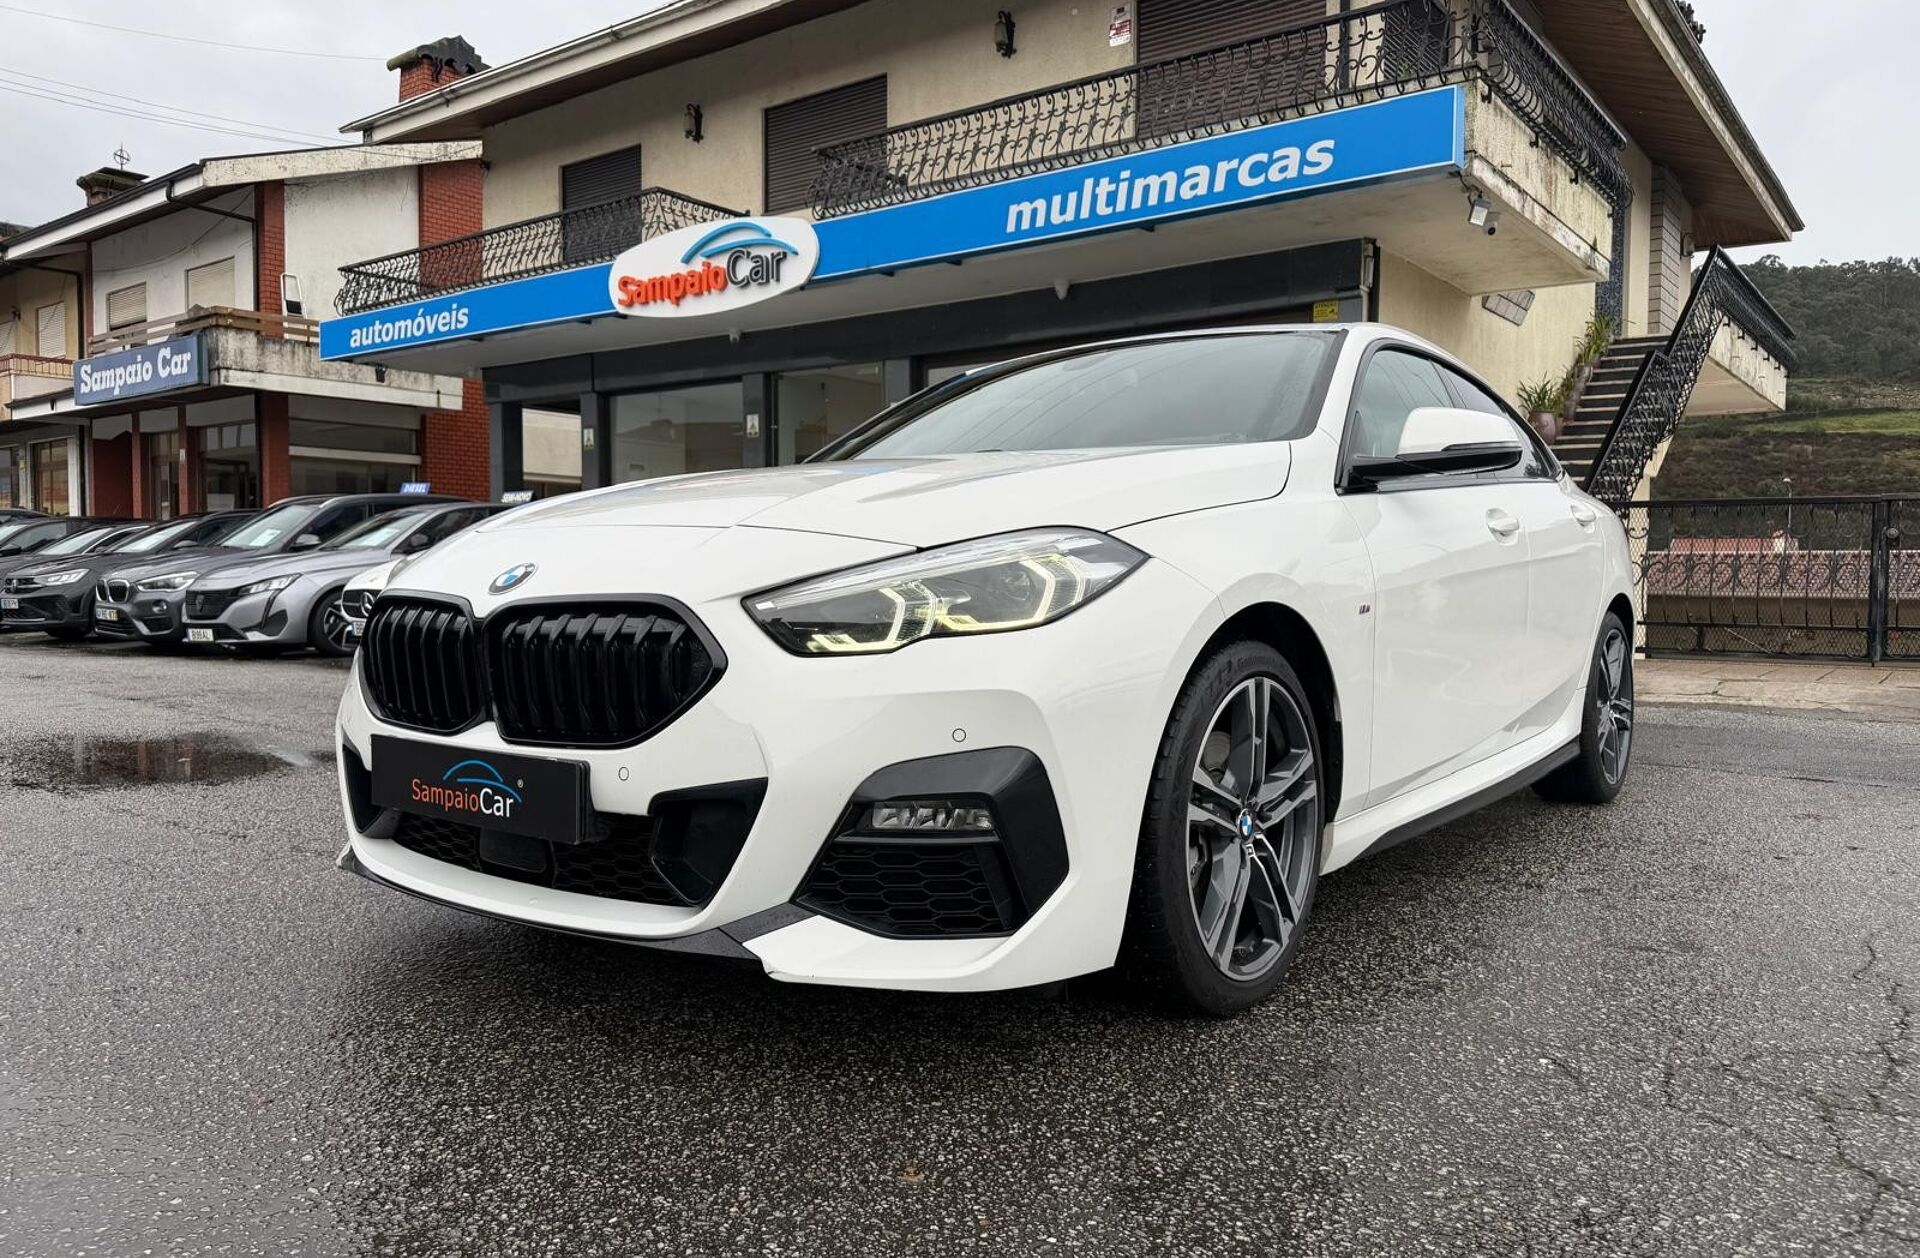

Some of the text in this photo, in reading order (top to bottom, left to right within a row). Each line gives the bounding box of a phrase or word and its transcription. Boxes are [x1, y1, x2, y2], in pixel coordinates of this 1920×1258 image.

[1005, 138, 1336, 233] multimarcas
[350, 303, 469, 348] automóveis
[80, 346, 192, 396] Sampaio Car
